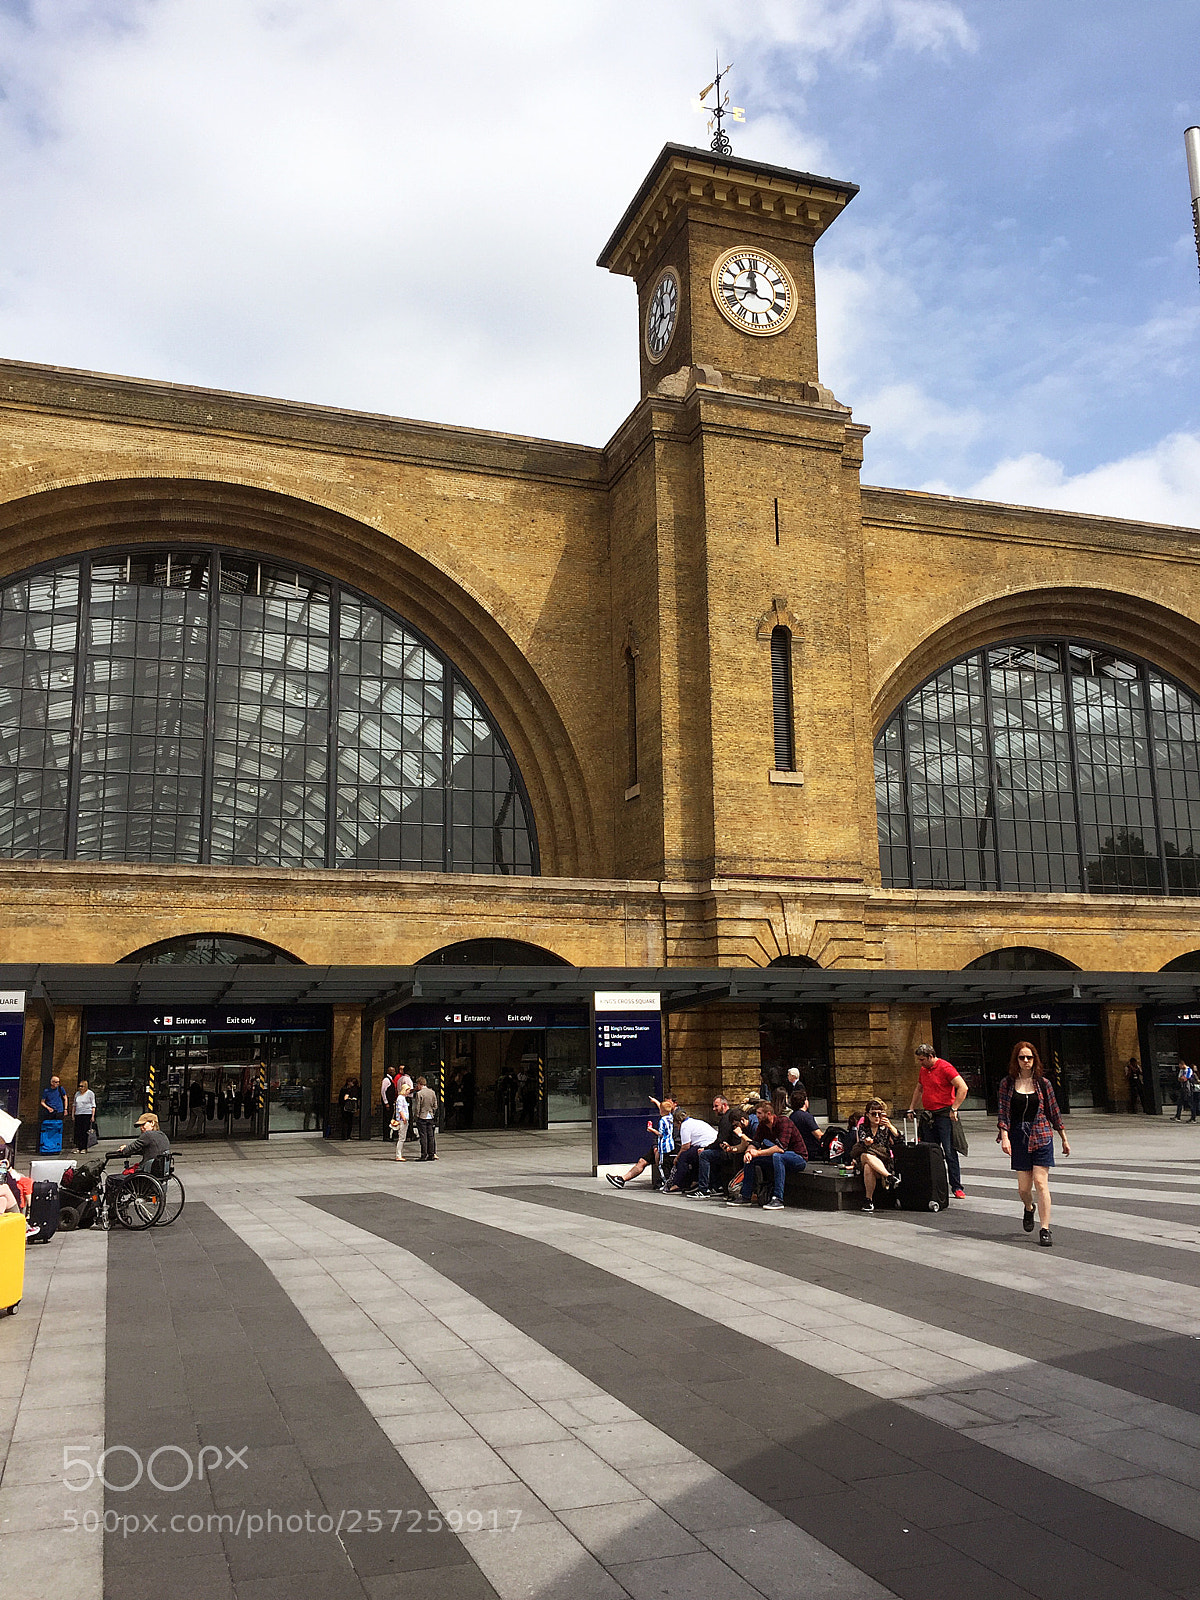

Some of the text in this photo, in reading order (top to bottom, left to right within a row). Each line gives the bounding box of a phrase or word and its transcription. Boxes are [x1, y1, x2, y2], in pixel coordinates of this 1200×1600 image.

[175, 1017, 207, 1025] Entrance
[226, 1016, 256, 1025] Exit only
[464, 1014, 491, 1022] Entrance
[519, 1014, 533, 1022] only
[116, 1046, 124, 1055] 7
